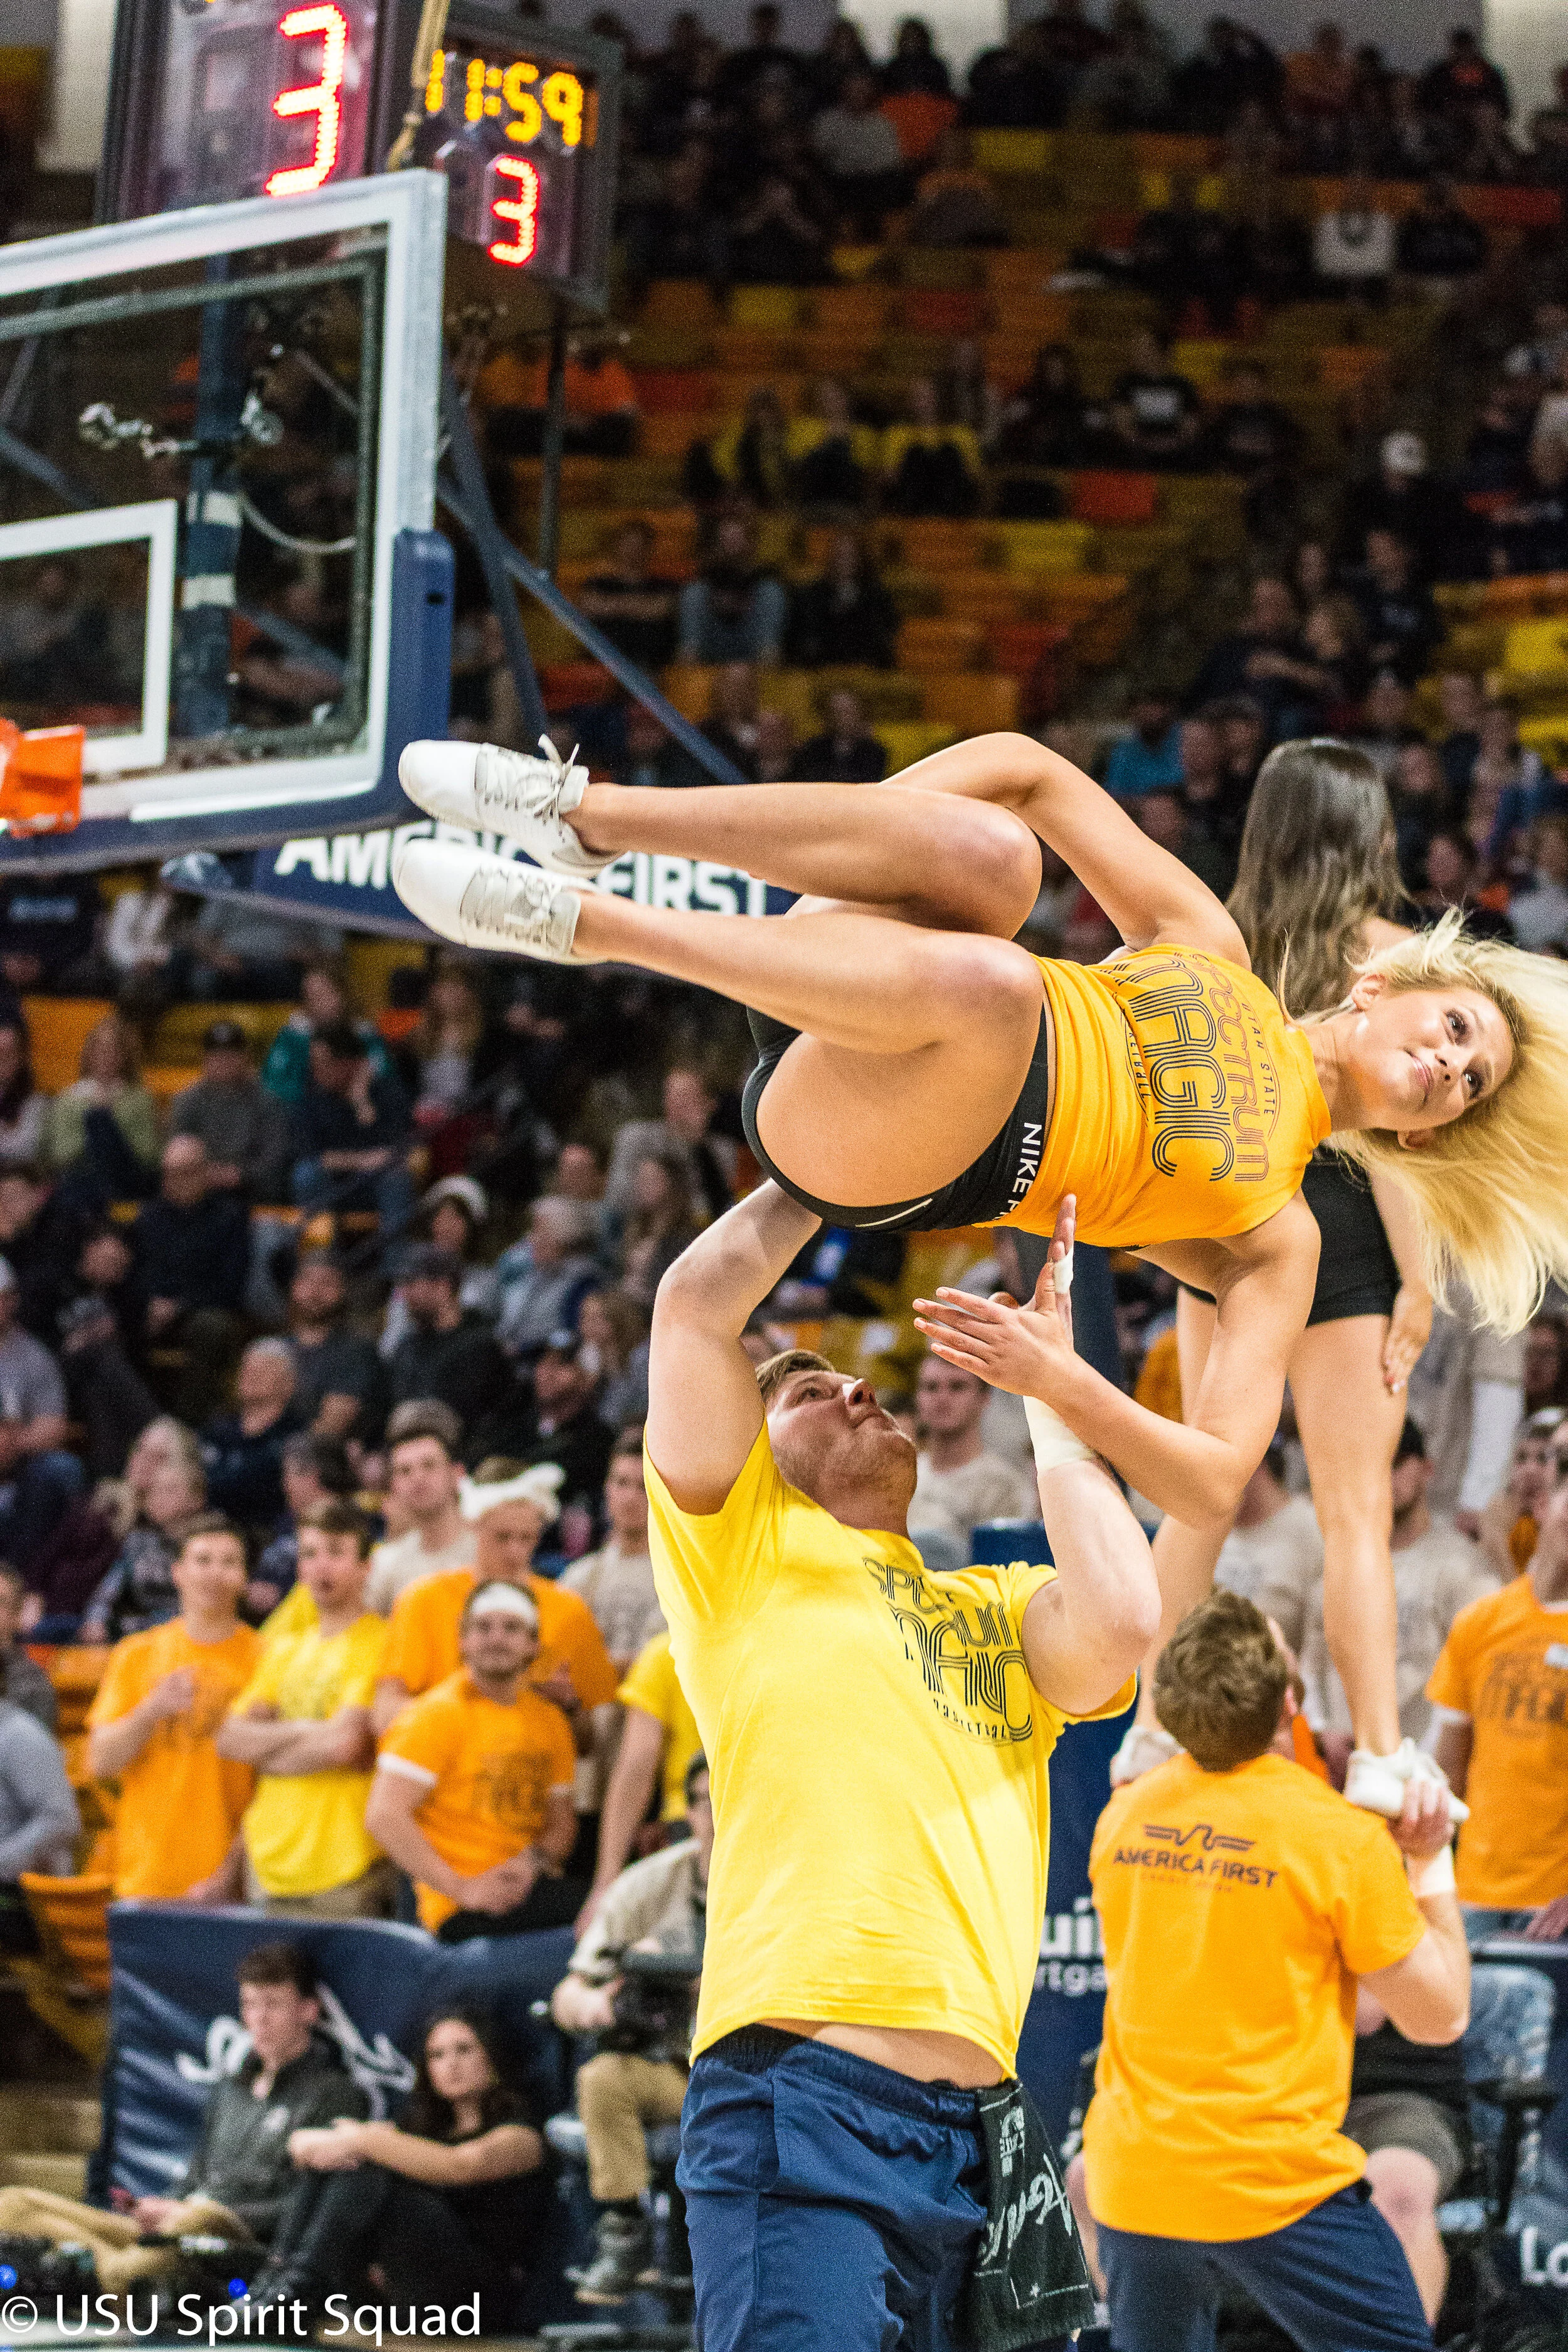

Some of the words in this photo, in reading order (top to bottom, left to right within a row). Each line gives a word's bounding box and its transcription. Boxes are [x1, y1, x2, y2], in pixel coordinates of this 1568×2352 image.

[264, 1, 348, 198] 3
[425, 48, 584, 147] 11:59
[488, 154, 541, 267] 3
[1110, 952, 1234, 1182] MAGIC
[1189, 953, 1269, 1182] SPECTRUM
[1241, 1002, 1264, 1049] UTAH
[1261, 1062, 1274, 1115] STATE
[1012, 1123, 1042, 1194] NIKE
[1113, 1848, 1204, 1874] AMERICA
[1209, 1858, 1279, 1888] FIRST
